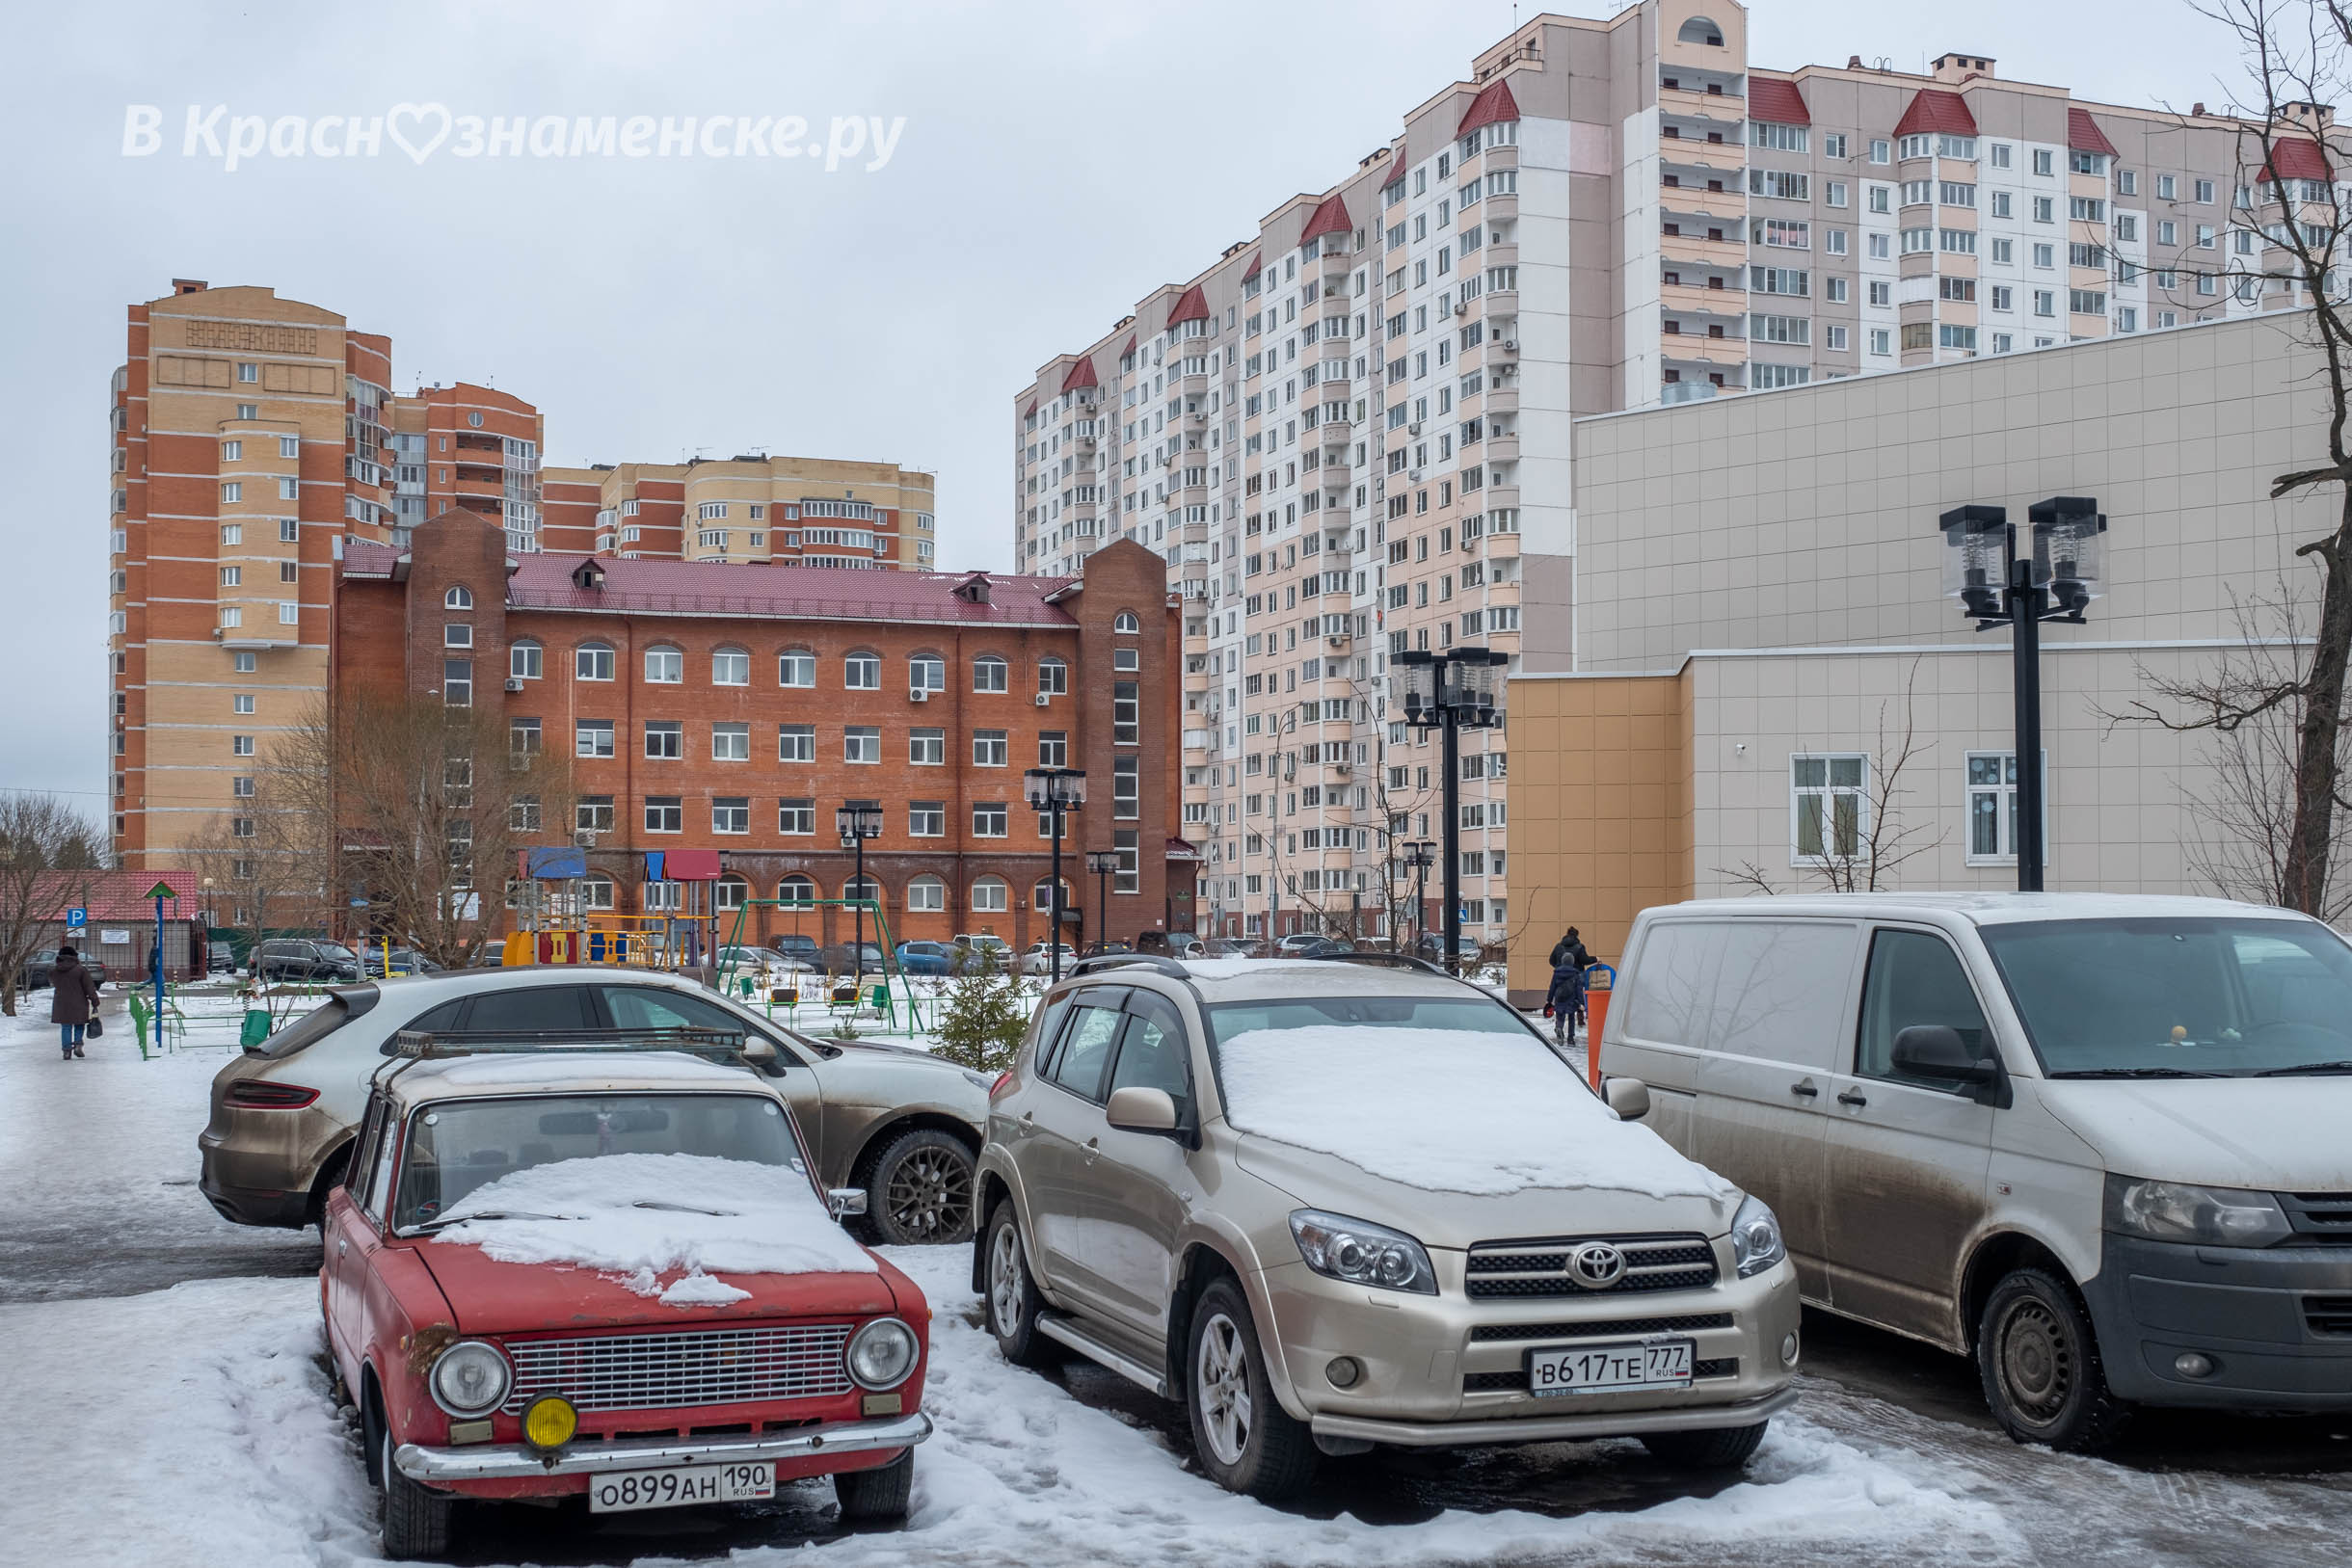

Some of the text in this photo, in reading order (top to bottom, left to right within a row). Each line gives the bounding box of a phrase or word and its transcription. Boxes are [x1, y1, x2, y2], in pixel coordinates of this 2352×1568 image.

[71, 910, 84, 925] P
[1542, 1347, 1685, 1385] В617ТЕ 777
[1656, 1369, 1674, 1377] RUS
[601, 1465, 766, 1506] О899АН 190
[733, 1487, 755, 1497] RUS
